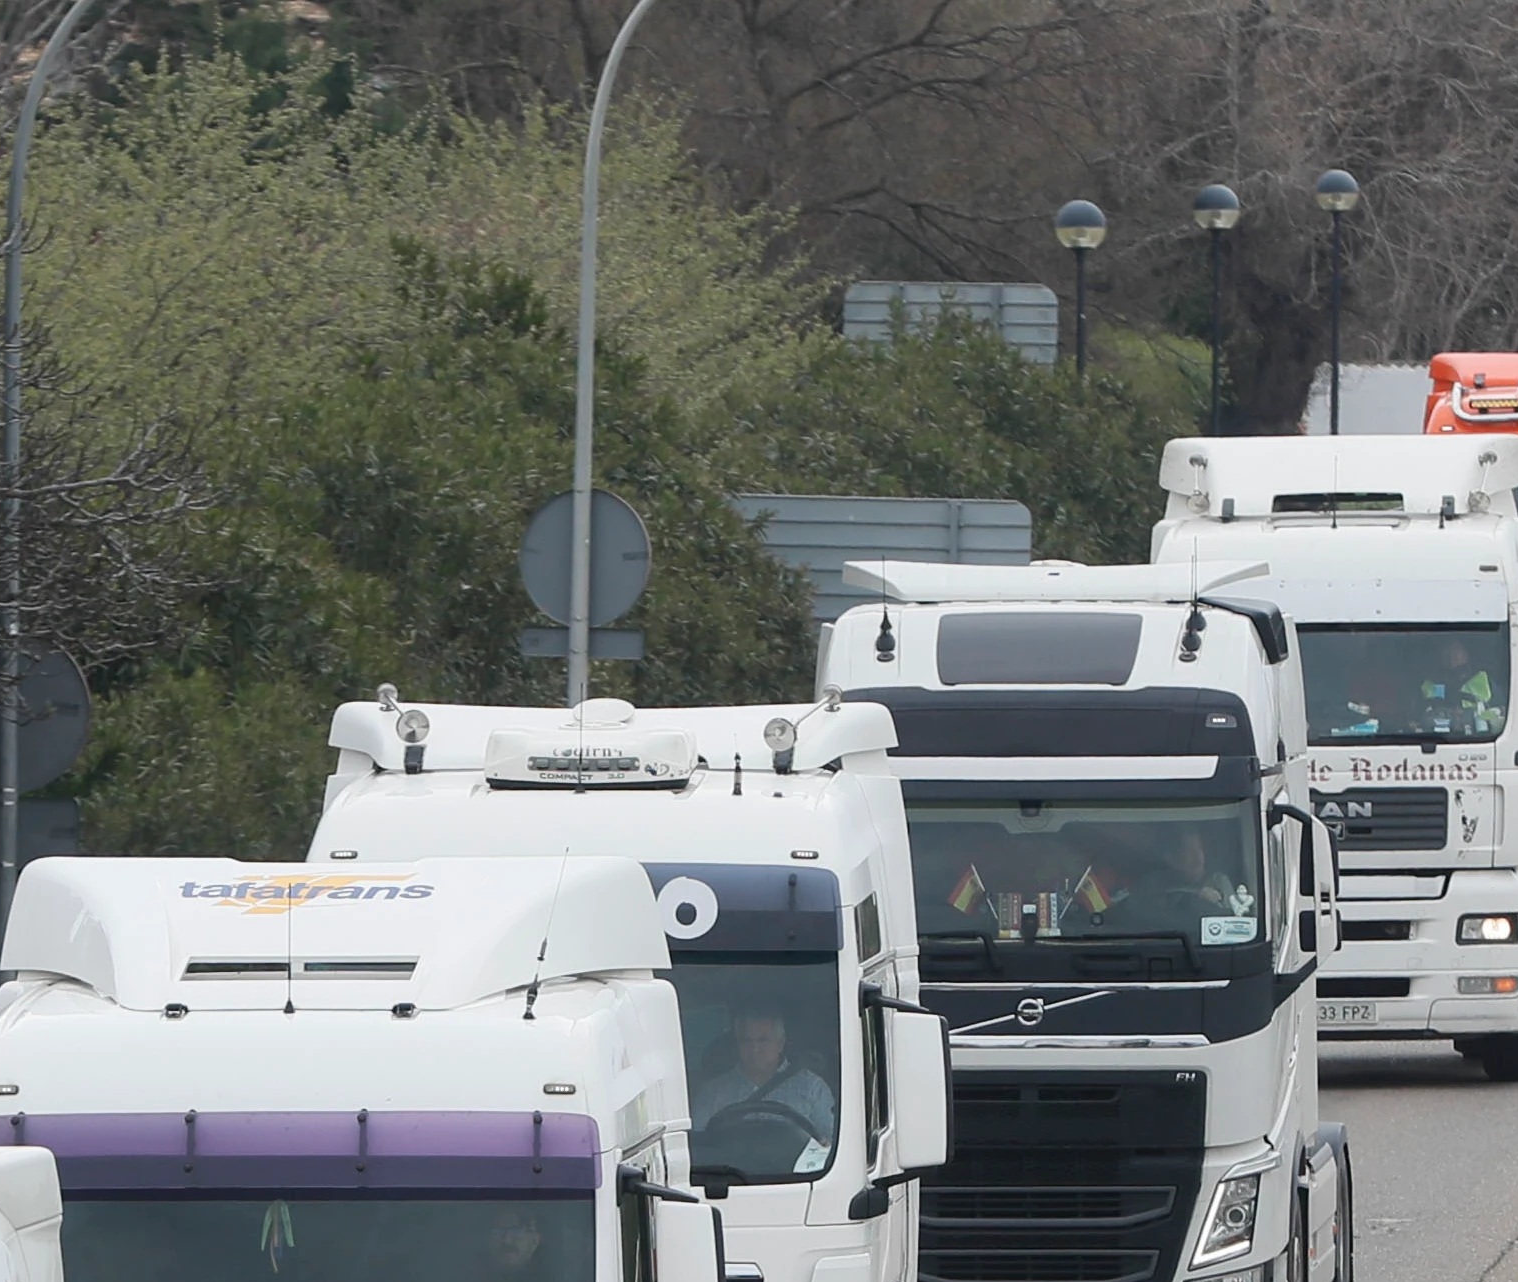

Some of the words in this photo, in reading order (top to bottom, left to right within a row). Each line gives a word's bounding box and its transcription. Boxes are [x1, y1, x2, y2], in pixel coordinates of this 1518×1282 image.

[1348, 757, 1479, 782] Rodanas
[1311, 802, 1373, 817] AN
[179, 881, 435, 900] tafatrans
[1317, 1005, 1336, 1020] 33
[1342, 1005, 1370, 1020] FPZ
